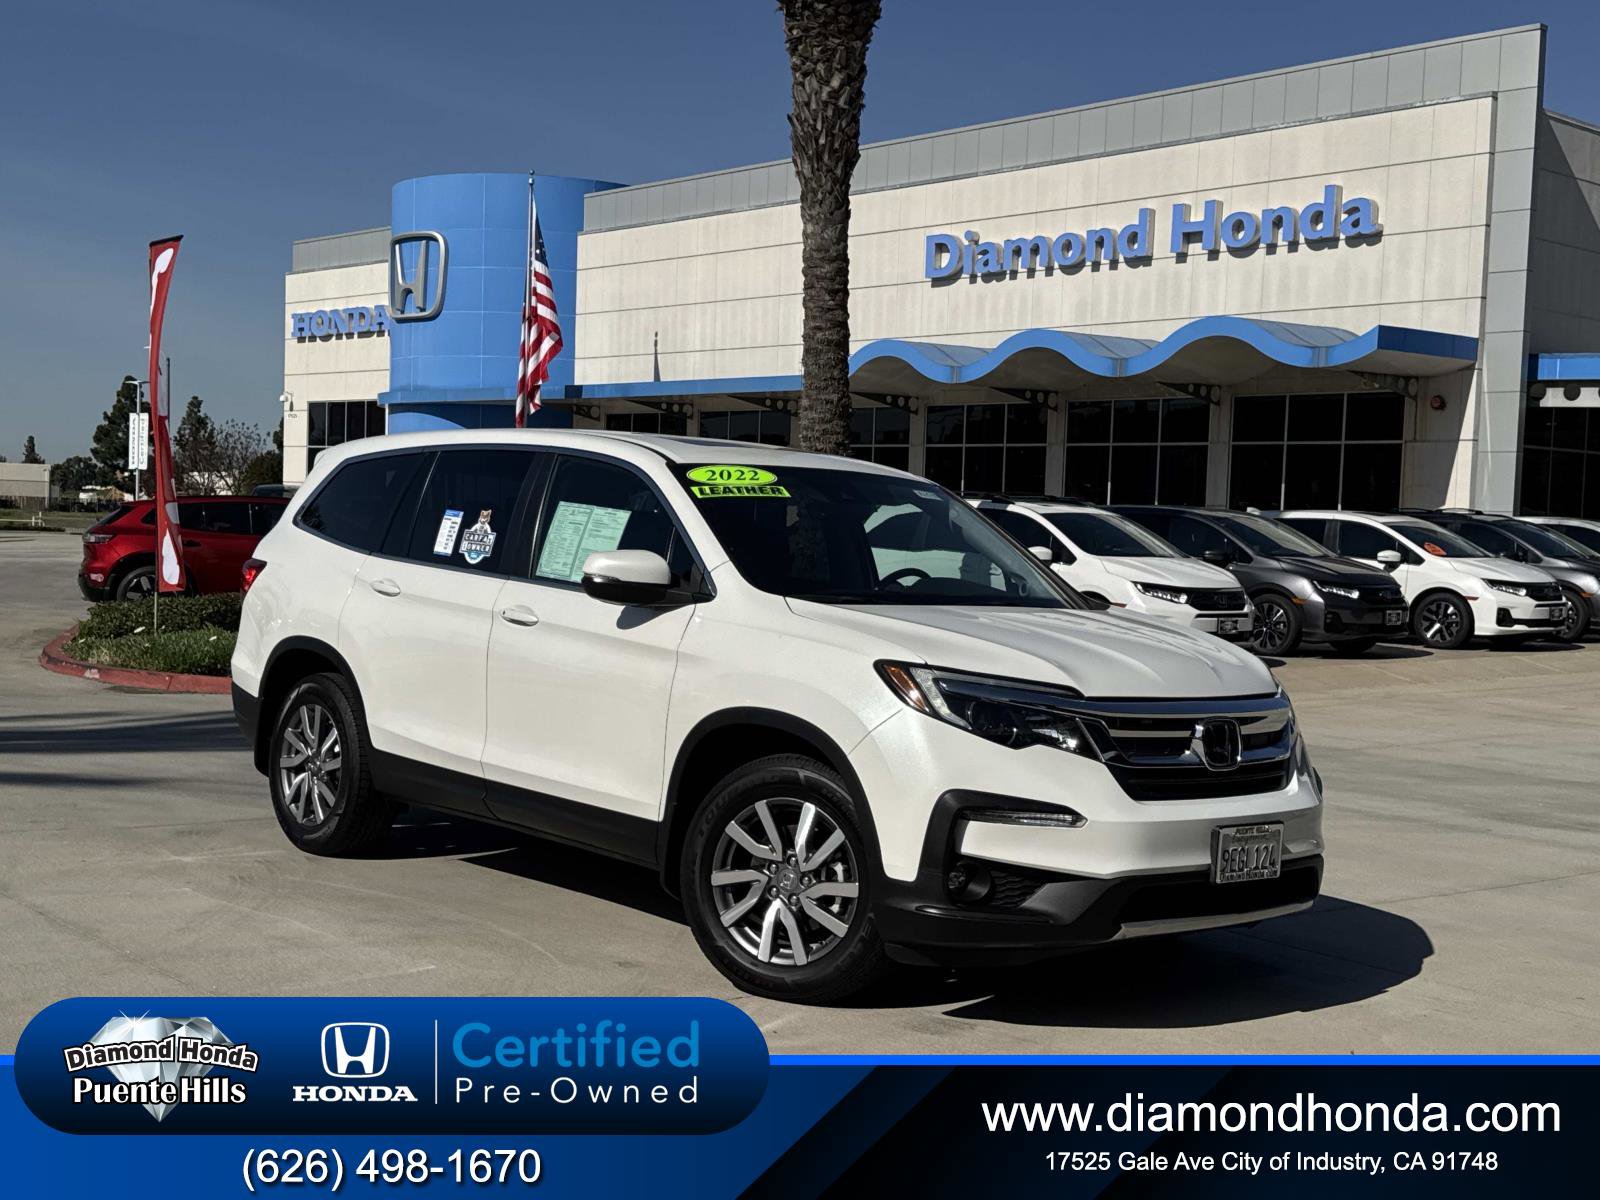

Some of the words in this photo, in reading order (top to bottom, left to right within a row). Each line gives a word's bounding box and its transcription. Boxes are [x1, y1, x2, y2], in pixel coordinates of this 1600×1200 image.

[925, 208, 1155, 279] Diamond
[1171, 184, 1382, 254] Honda
[291, 304, 390, 337] HONDA
[704, 469, 760, 481] 2022
[697, 486, 783, 496] LEATHER
[465, 533, 493, 544] CARFA
